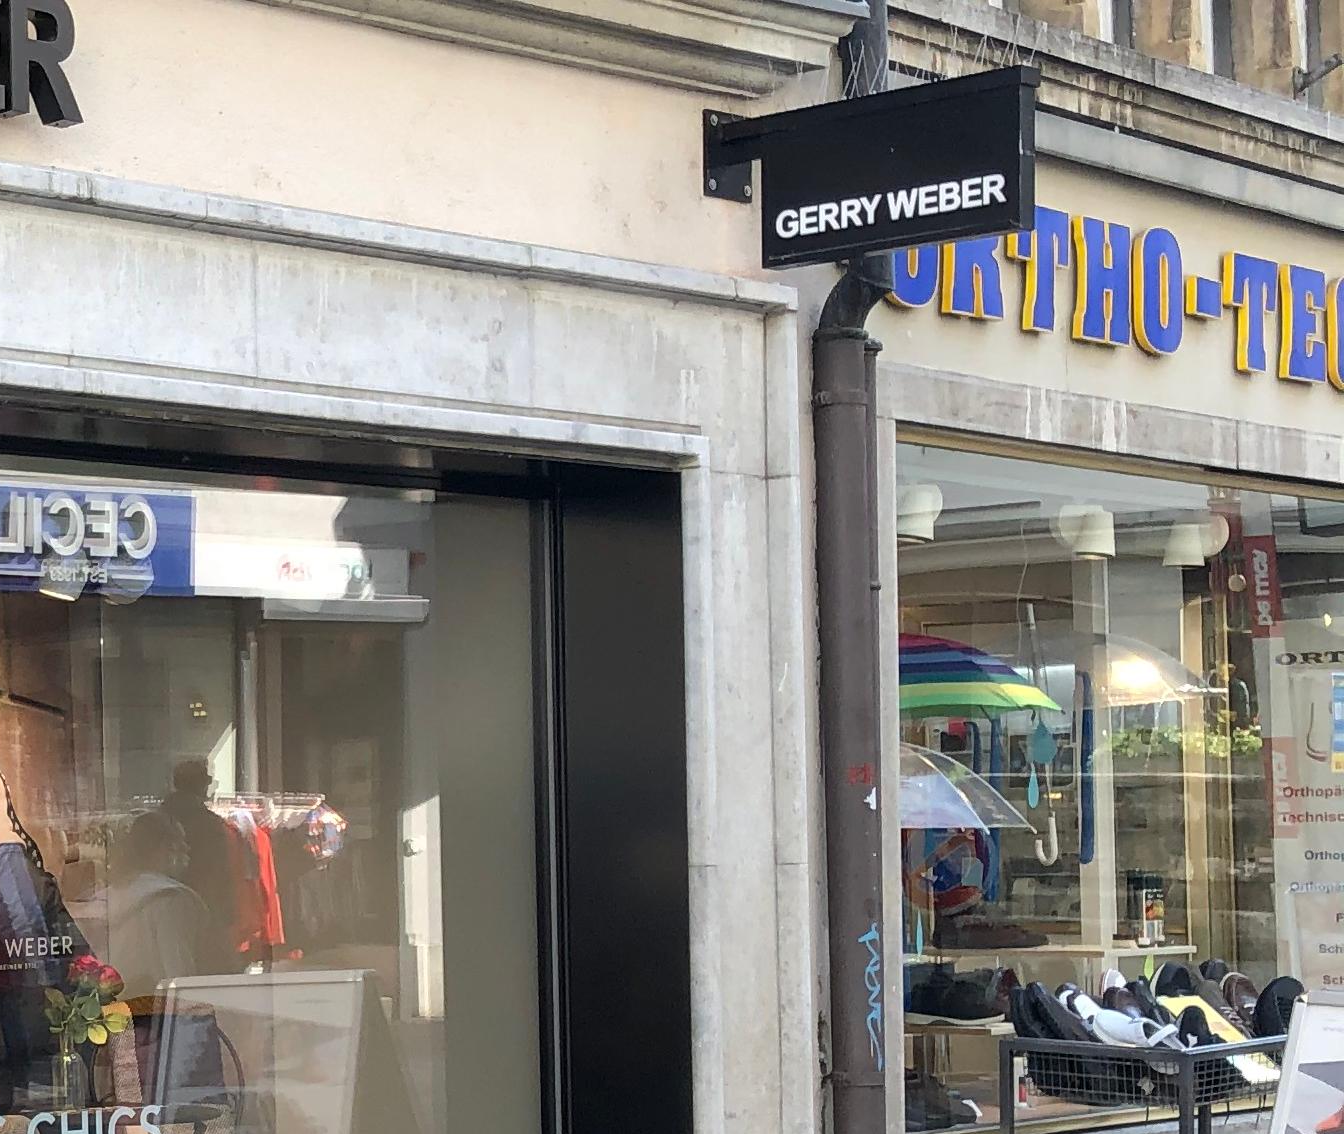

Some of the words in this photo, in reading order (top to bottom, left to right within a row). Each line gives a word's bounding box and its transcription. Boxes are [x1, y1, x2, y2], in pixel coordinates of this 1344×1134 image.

[775, 194, 882, 239] GERRY
[886, 173, 1007, 221] WEBER
[4, 935, 73, 958] WEBER
